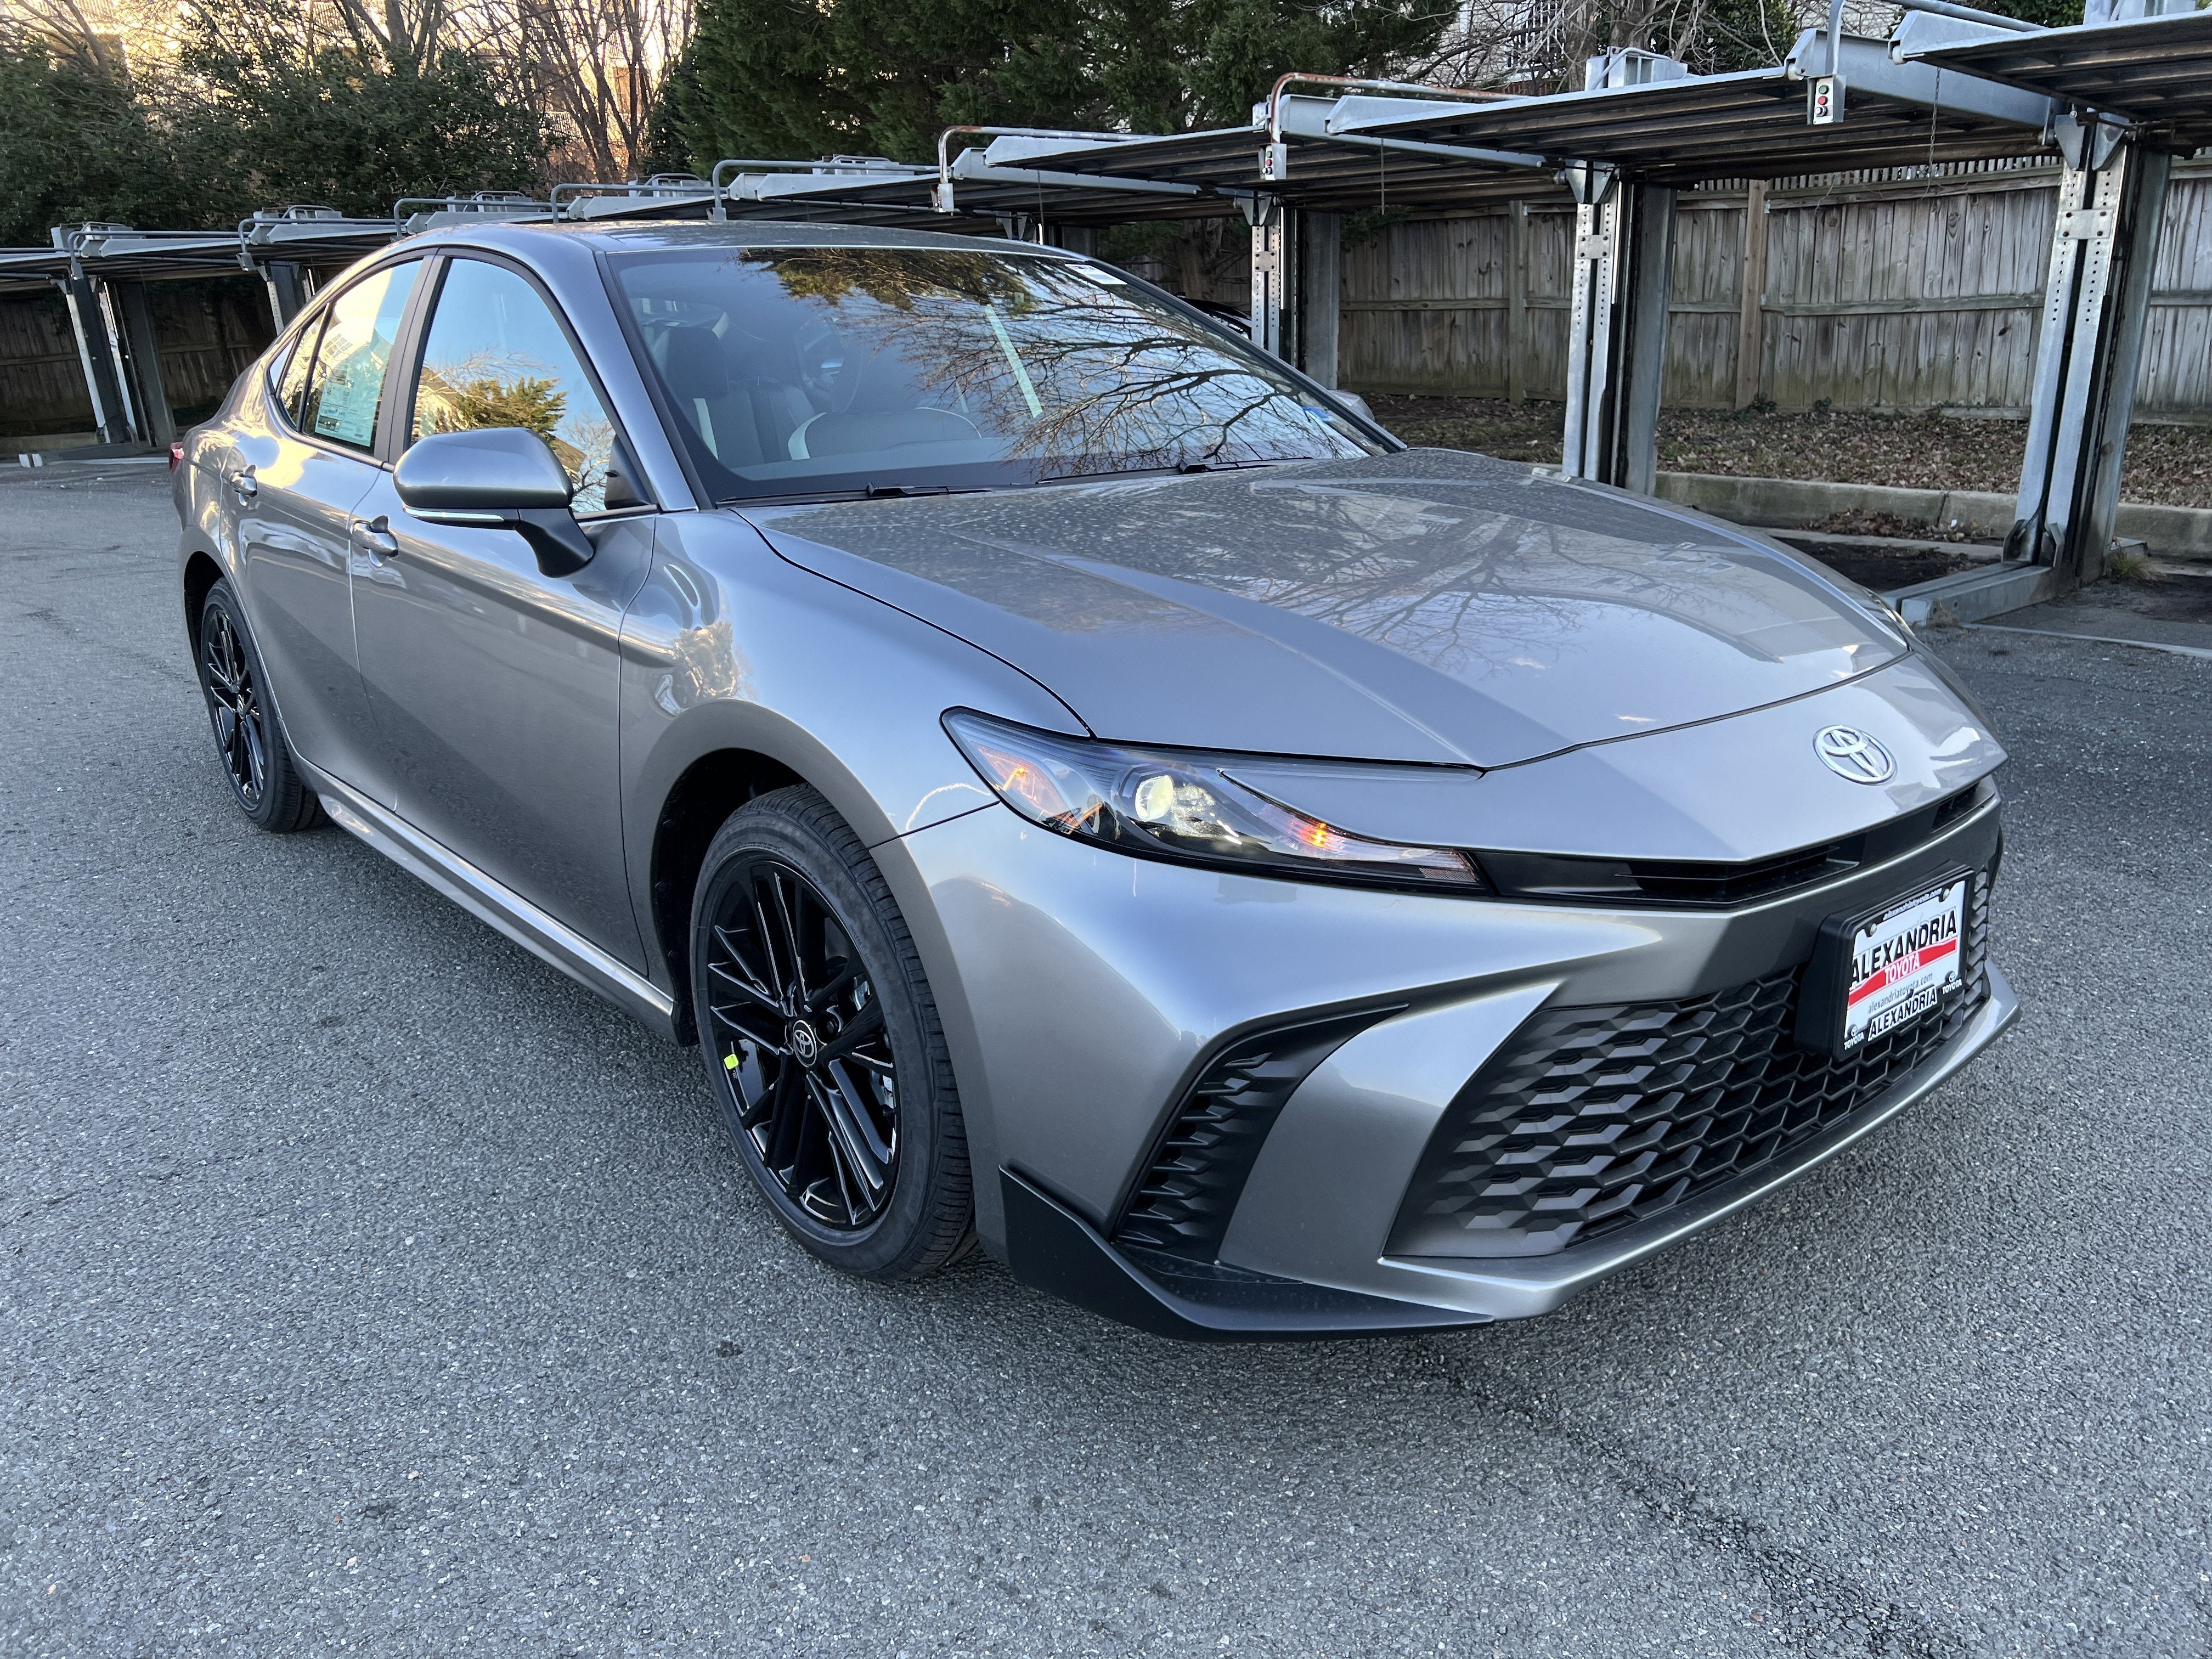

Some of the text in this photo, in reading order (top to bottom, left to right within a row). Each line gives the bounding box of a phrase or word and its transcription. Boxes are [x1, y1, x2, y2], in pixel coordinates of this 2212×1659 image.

[1851, 910, 1957, 983] ALEXANDRIA
[1884, 952, 1921, 985] TOYOTA
[1942, 978, 1962, 995] TOYOTA
[1867, 972, 1934, 1014] alexandriatoyota.com
[1869, 988, 1937, 1037] ALEXANDRIA
[1844, 1031, 1865, 1051] TOYOTA
